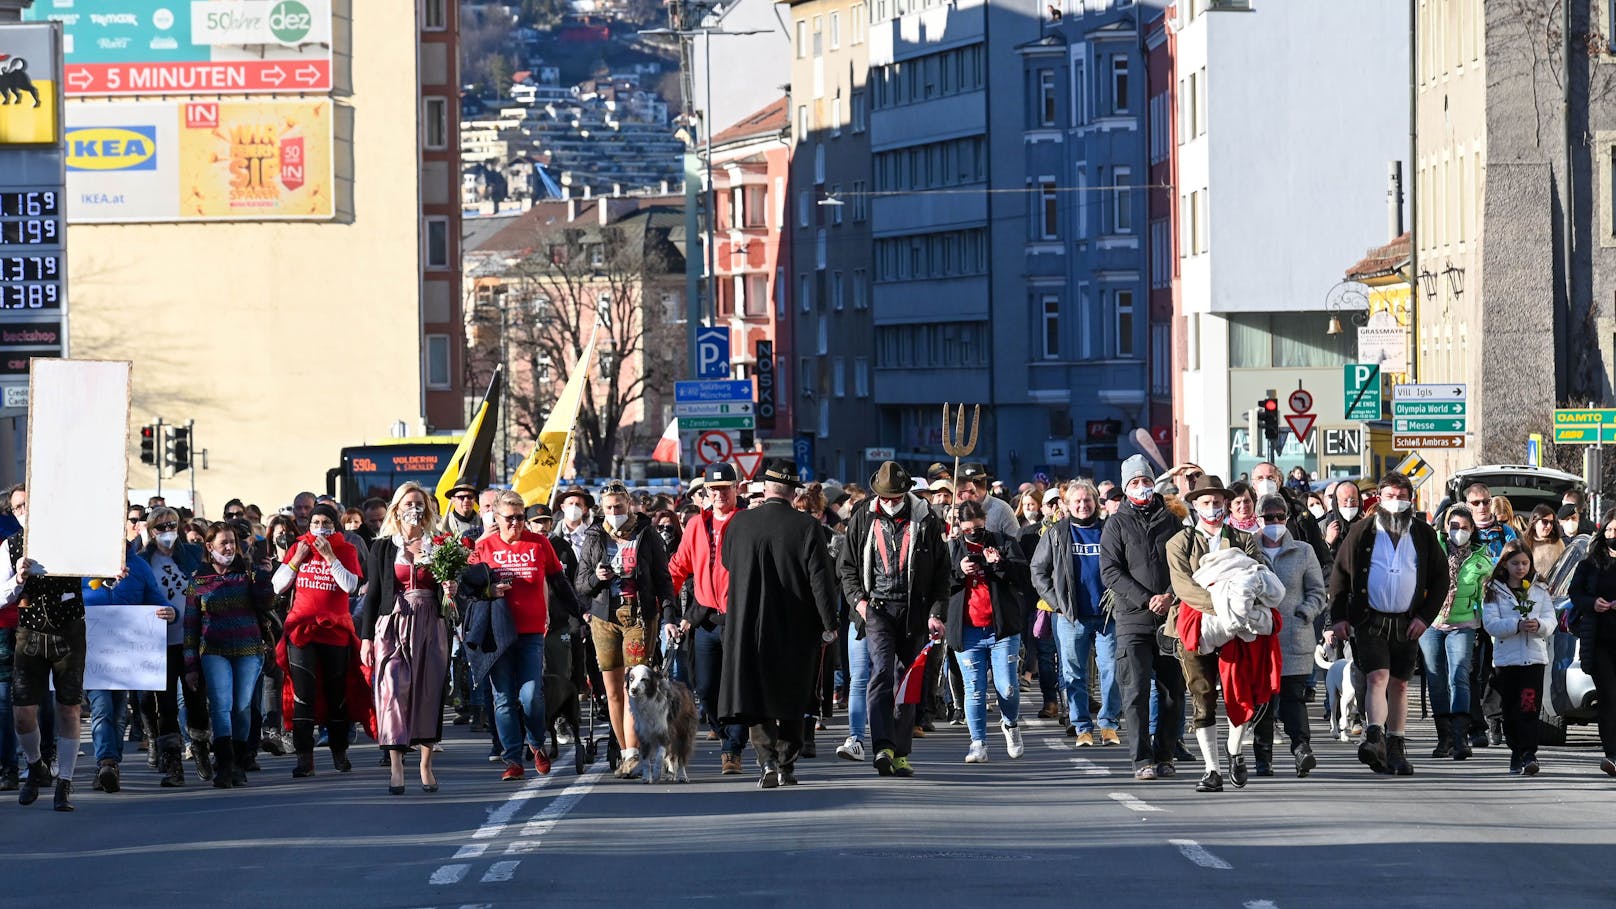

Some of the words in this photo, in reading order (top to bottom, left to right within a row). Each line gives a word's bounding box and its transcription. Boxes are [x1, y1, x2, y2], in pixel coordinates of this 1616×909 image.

[270, 4, 310, 30] dez
[107, 68, 120, 88] 5
[129, 66, 246, 88] MINUTEN
[188, 105, 217, 122] IN
[282, 165, 303, 179] IN
[81, 193, 125, 204] IKEA.at
[700, 343, 719, 374] P
[758, 343, 774, 417] NOSKO
[1355, 366, 1370, 389] P
[1397, 388, 1411, 396] Vill
[1417, 388, 1433, 397] Igls
[1397, 404, 1426, 414] Olympia
[1428, 403, 1449, 413] World
[689, 419, 721, 427] Zentrum
[1409, 421, 1435, 430] Messe
[1396, 437, 1421, 447] Schloß
[1422, 437, 1449, 447] Ambras
[493, 549, 536, 564] Tirol
[300, 562, 331, 575] Tirole
[296, 577, 337, 592] Mutant
